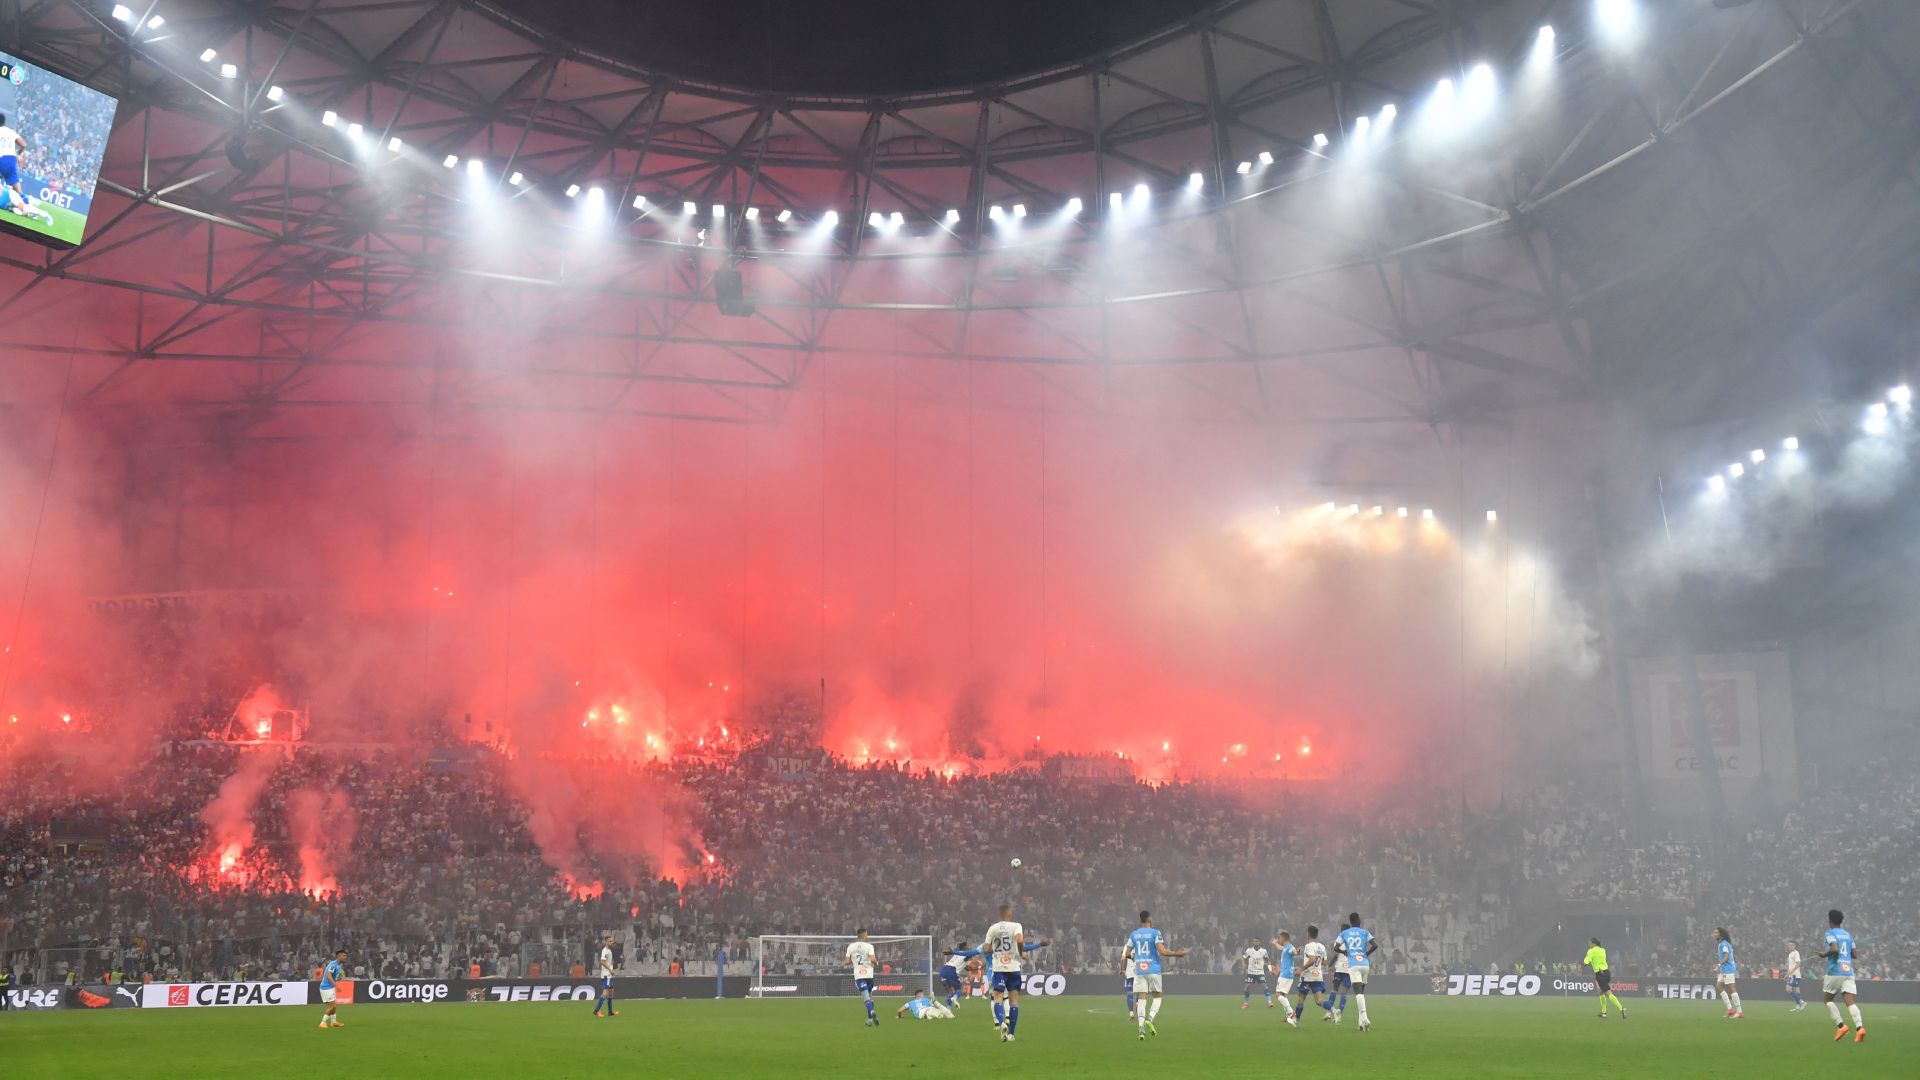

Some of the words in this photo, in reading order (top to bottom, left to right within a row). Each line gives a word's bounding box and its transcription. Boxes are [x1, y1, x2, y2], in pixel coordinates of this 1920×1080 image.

[1674, 755, 1740, 771] CEAC
[993, 936, 1012, 953] 25
[1136, 940, 1150, 957] 14
[1347, 936, 1363, 950] 22
[1840, 942, 1848, 957] 4
[856, 954, 864, 966] 2
[368, 980, 448, 1003] Orange
[1447, 974, 1541, 996] JEFCO
[1553, 979, 1594, 992] Orange
[196, 983, 283, 1006] CEPAC
